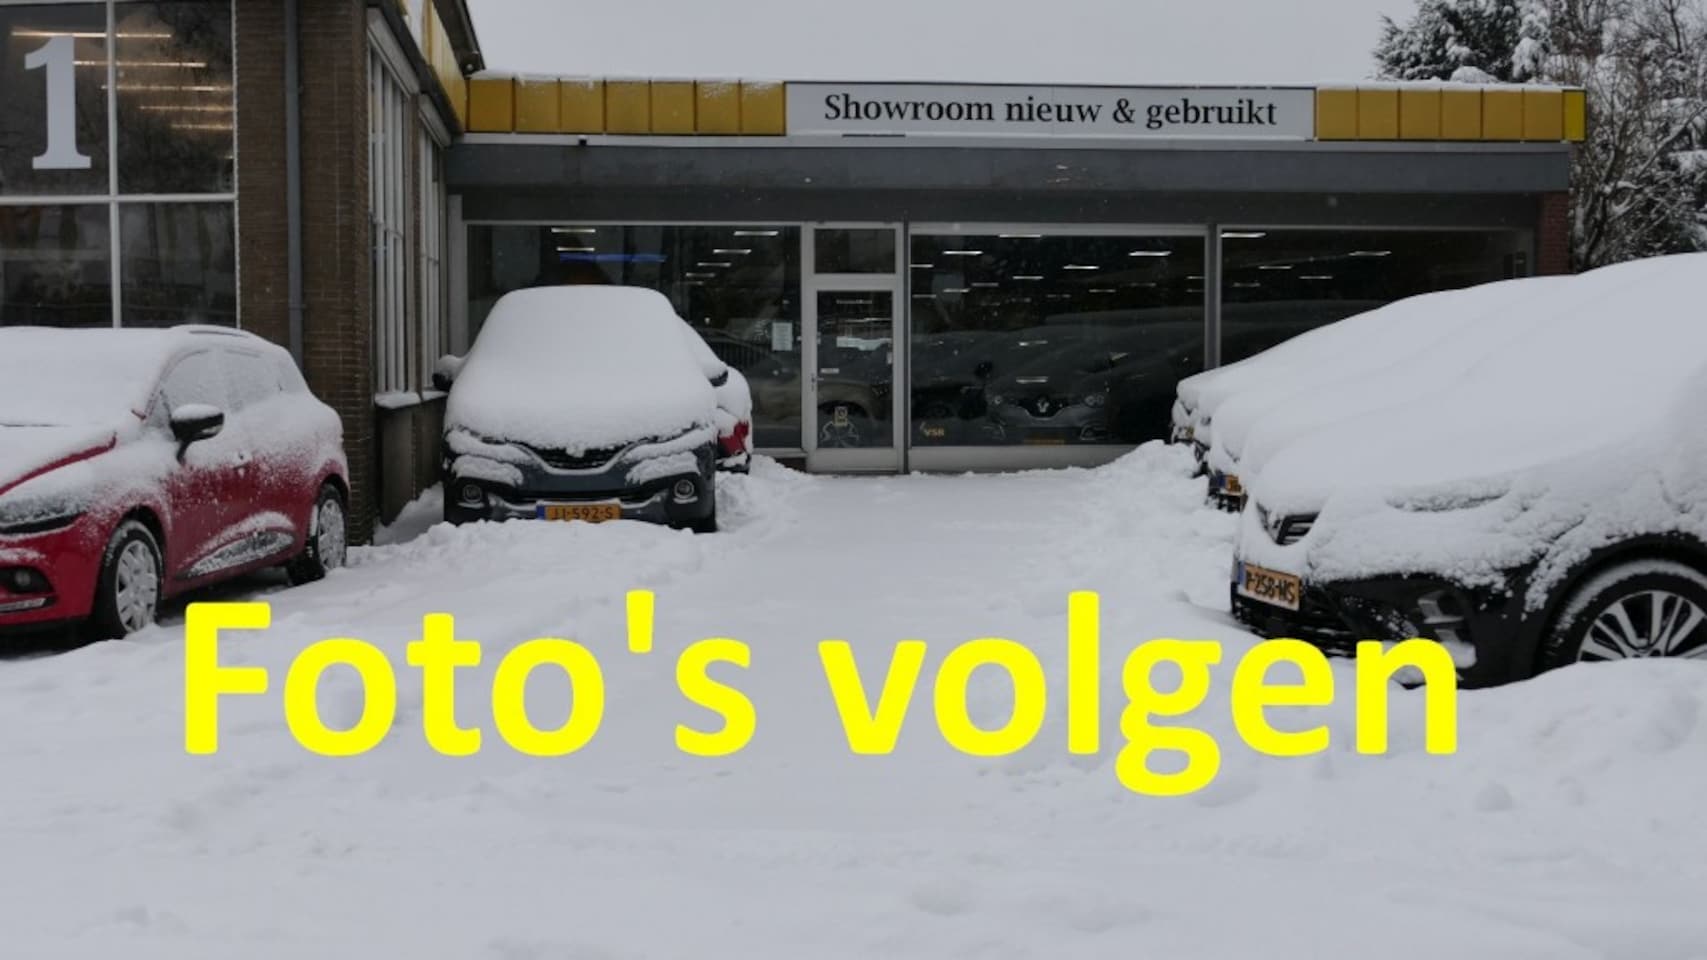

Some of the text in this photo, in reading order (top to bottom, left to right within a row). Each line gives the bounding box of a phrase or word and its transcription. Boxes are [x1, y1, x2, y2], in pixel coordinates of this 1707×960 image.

[25, 37, 92, 169] 1
[825, 93, 1277, 130] Showroom nieuw & gebruikt
